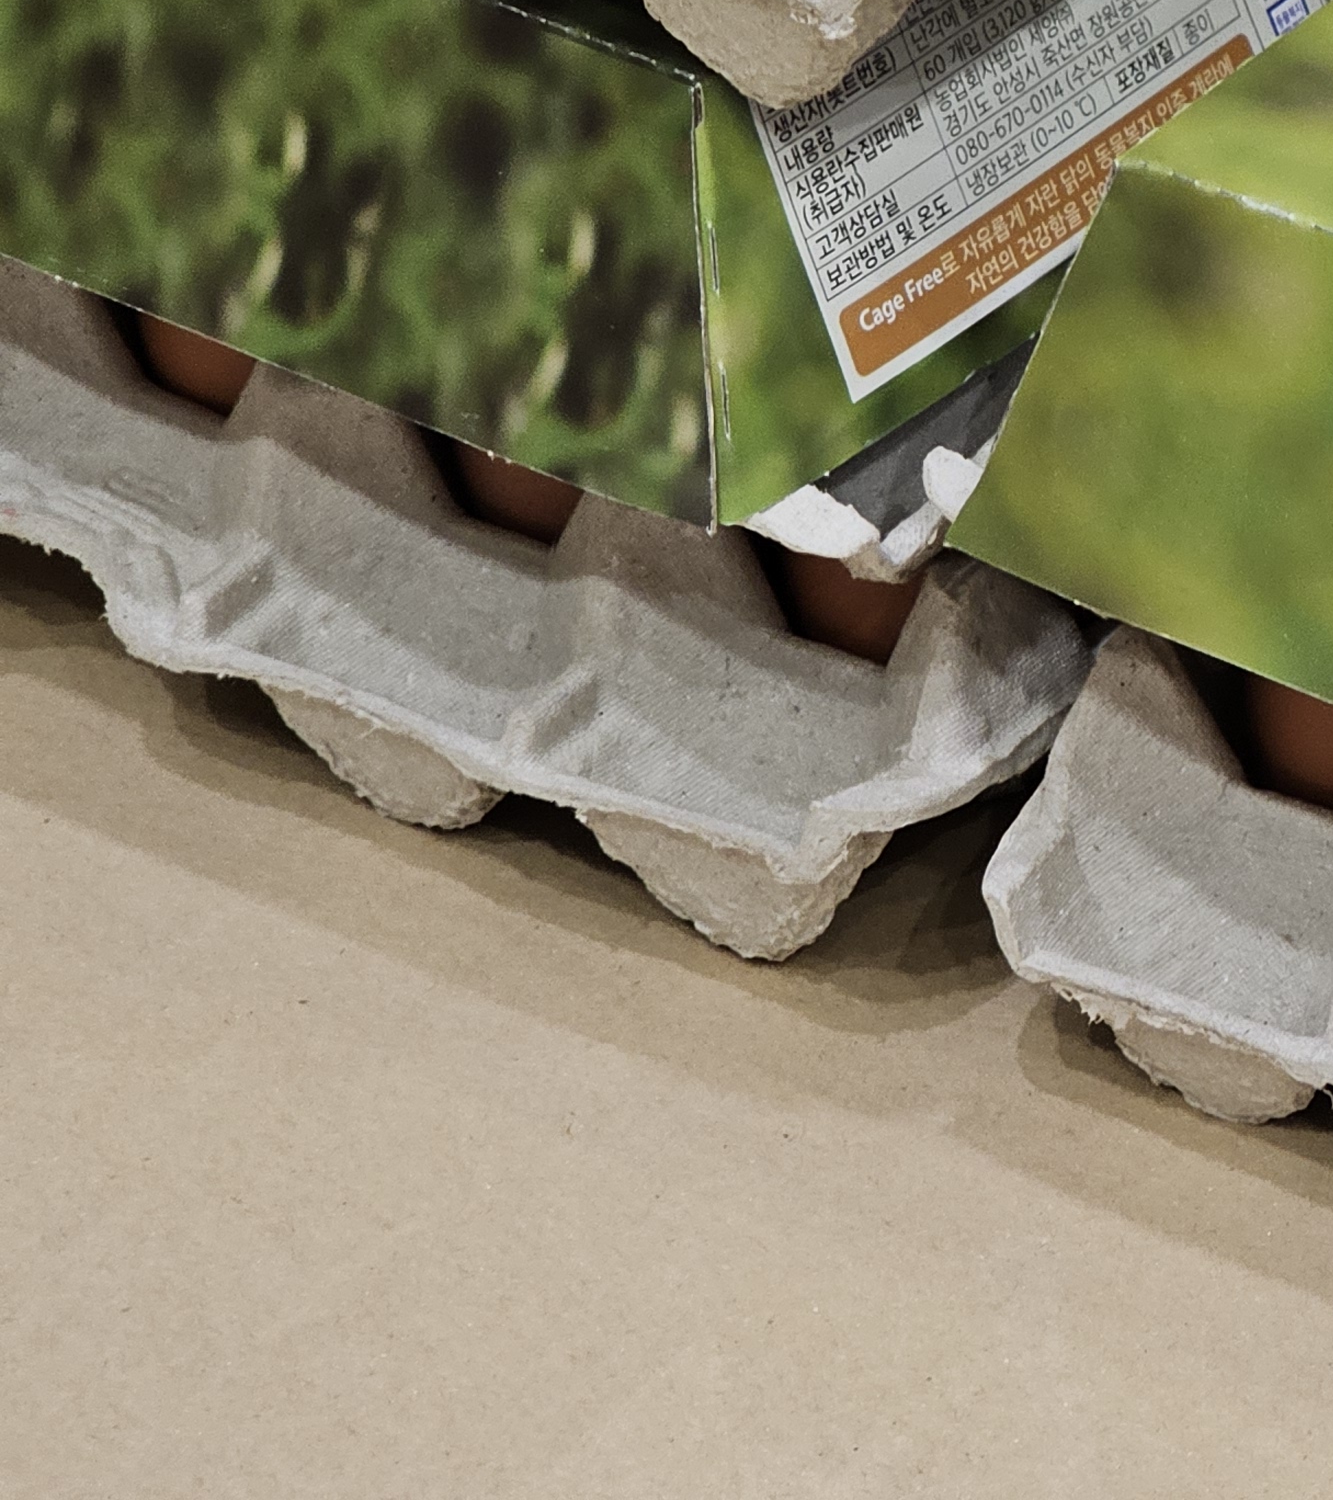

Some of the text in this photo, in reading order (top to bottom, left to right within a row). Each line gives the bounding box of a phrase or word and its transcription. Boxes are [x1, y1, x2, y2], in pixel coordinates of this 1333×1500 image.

[1114, 36, 1176, 103] 포장재질
[1181, 7, 1215, 47] 종이
[942, 90, 994, 147] 경기도
[992, 55, 1042, 112] 안성시
[954, 67, 1065, 177] 080-670-0114
[964, 138, 1031, 207] 냉장보관
[814, 180, 902, 269] 고객상담실
[826, 193, 953, 299] 보관방법 및 온도
[858, 250, 961, 332] Cage Free로
